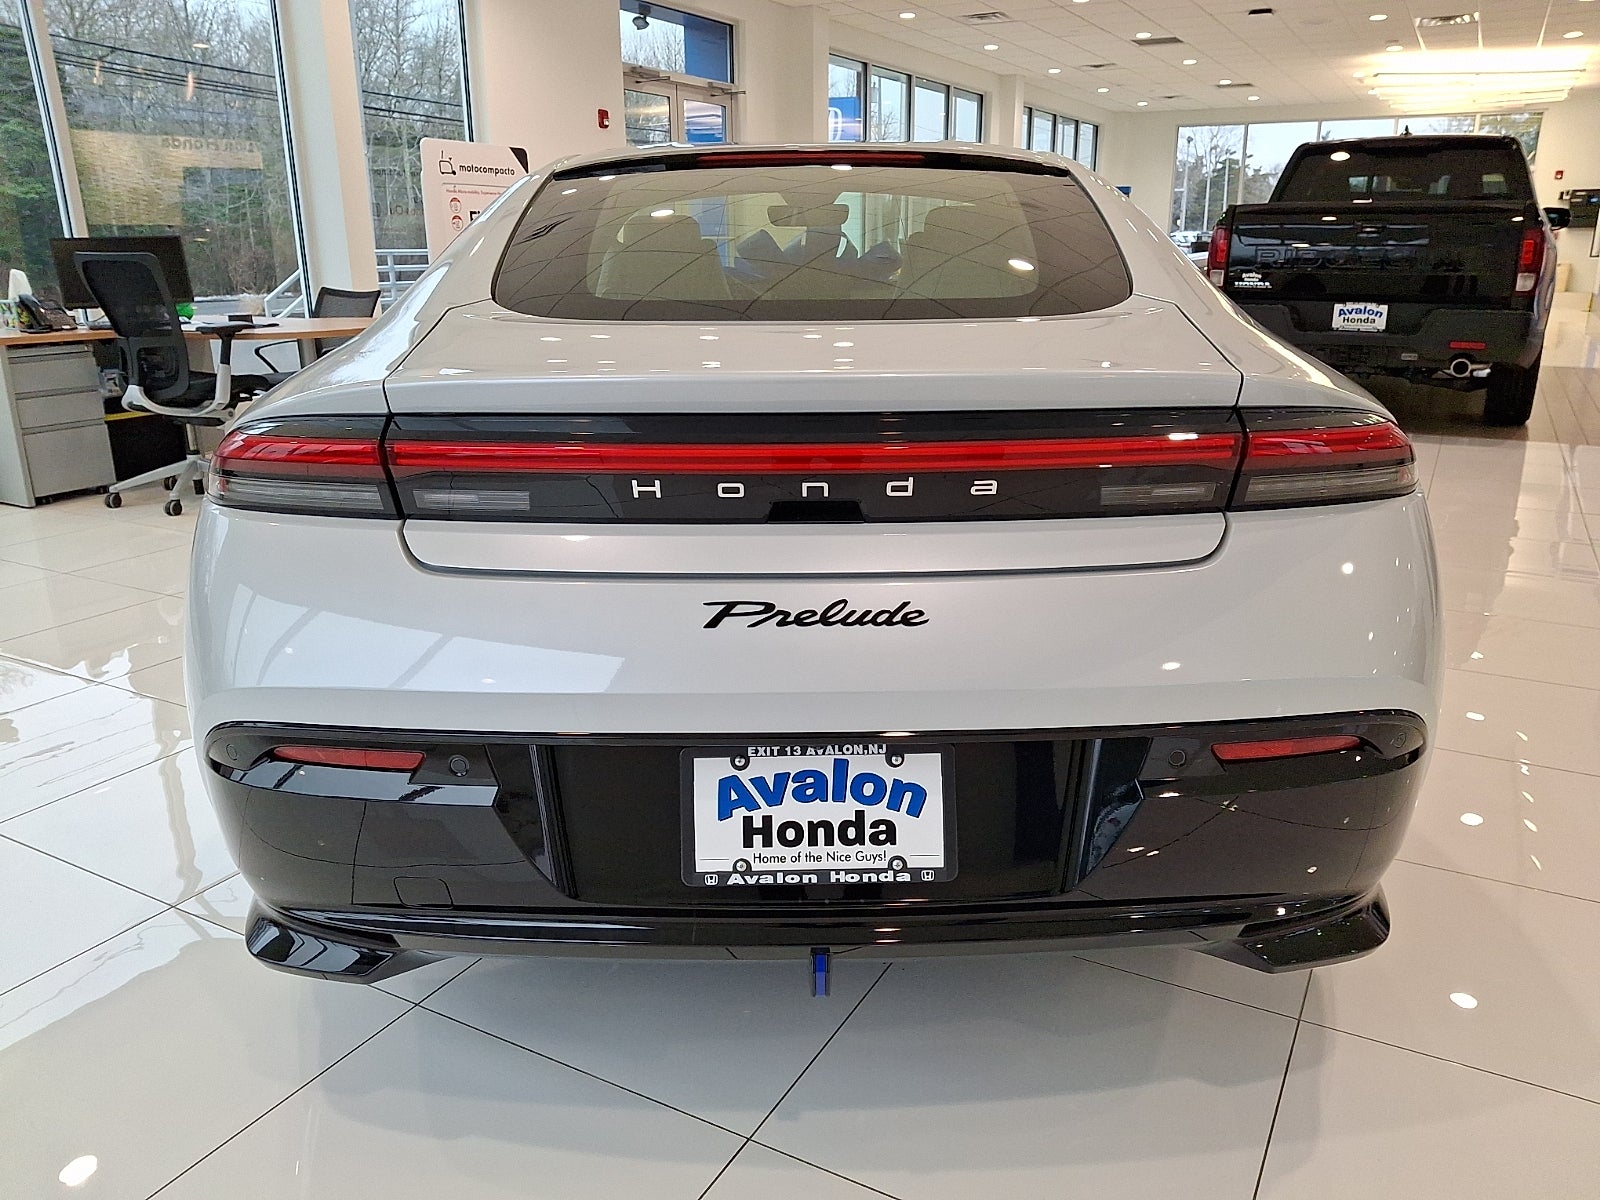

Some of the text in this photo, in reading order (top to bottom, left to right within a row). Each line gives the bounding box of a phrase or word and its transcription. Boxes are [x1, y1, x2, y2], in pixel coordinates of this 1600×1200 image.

[459, 164, 515, 177] motocompacto
[1338, 306, 1383, 318] Avalon
[1343, 316, 1376, 324] Honda
[631, 476, 998, 499] Honda
[703, 599, 930, 629] Prelude
[747, 746, 781, 757] EXIT
[784, 746, 802, 756] 13
[717, 758, 928, 822] Avalon
[742, 809, 897, 849] Honda
[753, 850, 887, 864] Home of the Nice Guys!
[726, 871, 818, 885] Avalon
[830, 870, 911, 883] Honda
